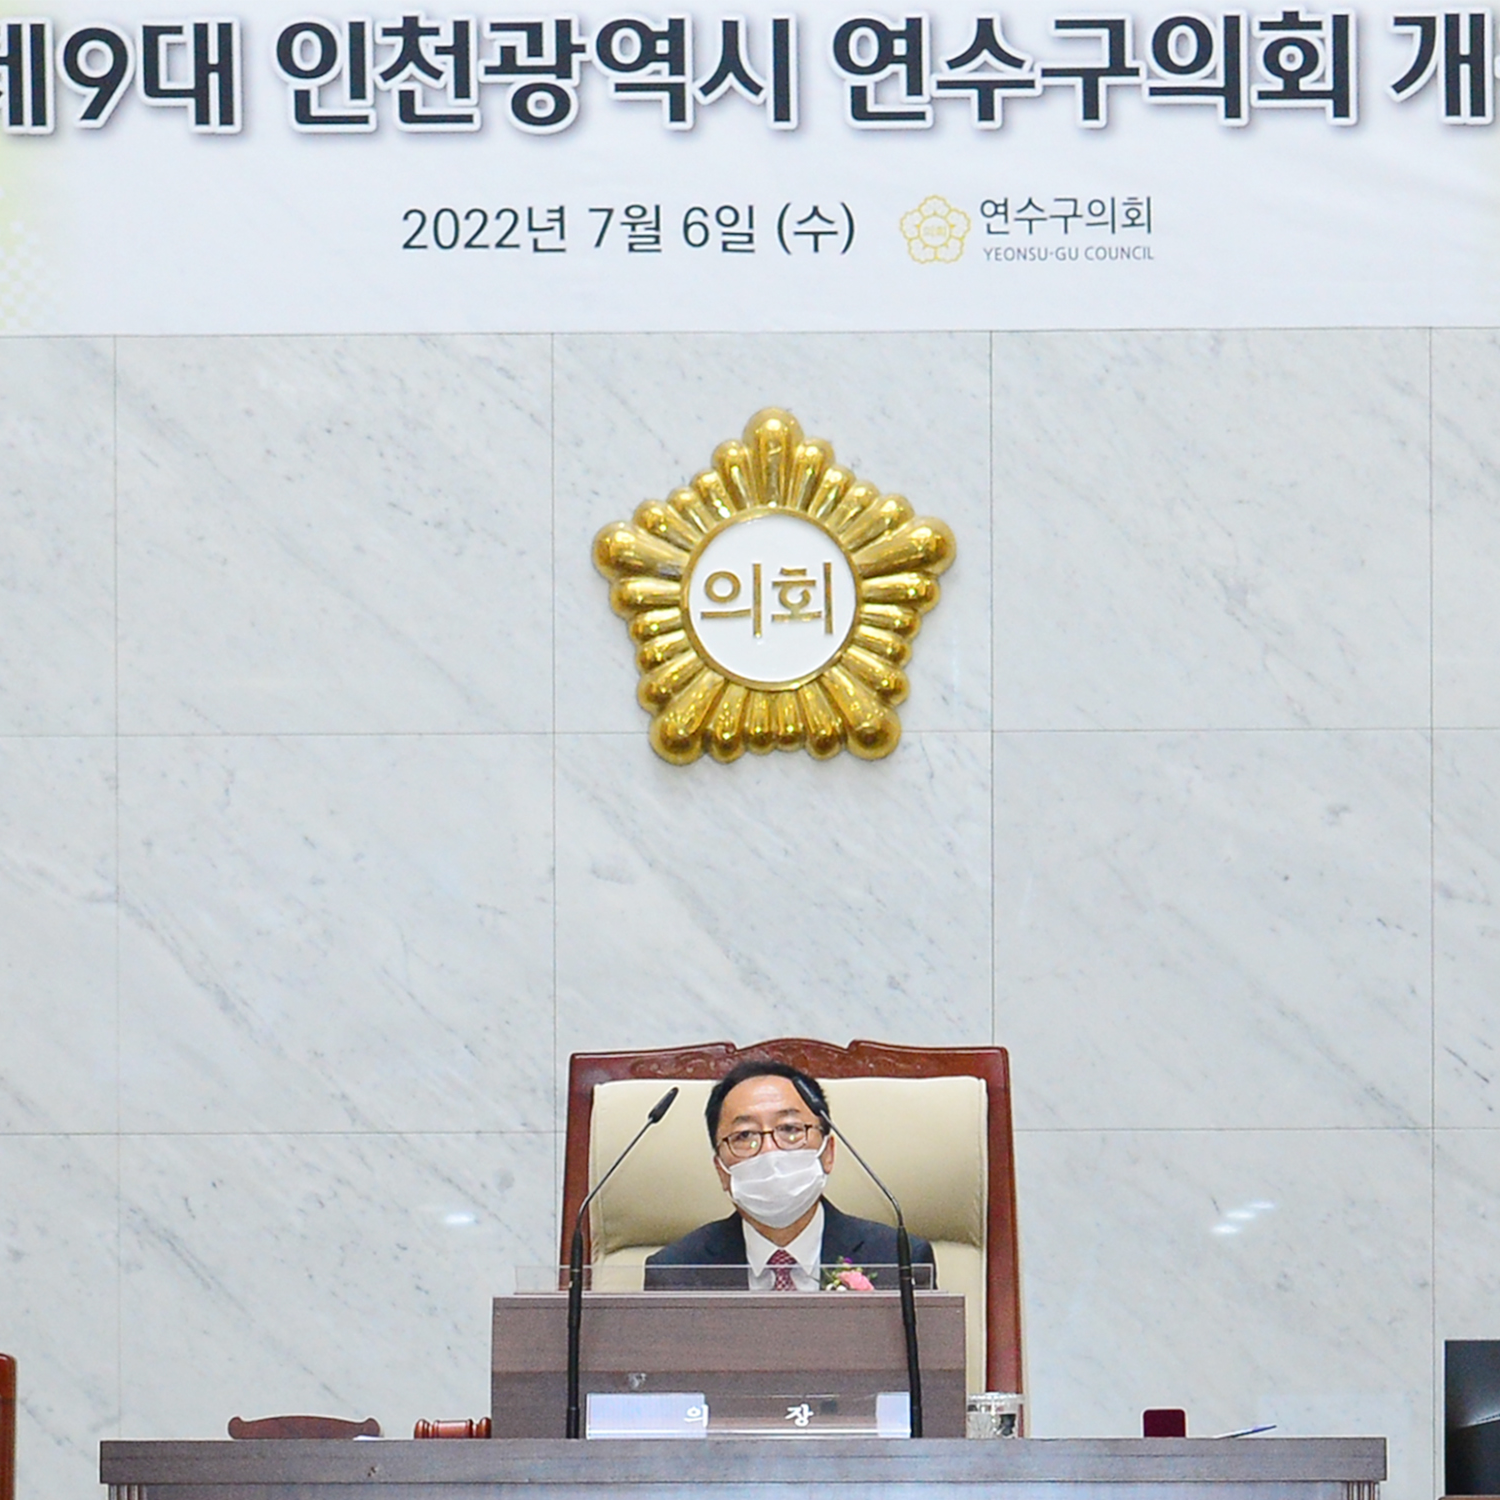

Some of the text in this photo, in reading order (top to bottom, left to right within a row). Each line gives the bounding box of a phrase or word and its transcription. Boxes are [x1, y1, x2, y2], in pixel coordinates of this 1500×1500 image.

[275, 15, 792, 127] 인천광역시
[832, 9, 1351, 122] 연수구의회
[402, 201, 856, 255] 2022년 7월 6일 (수)
[979, 196, 1153, 235] 연수구의회
[983, 244, 1155, 262] YEONSU-GU COUNCIL
[700, 561, 834, 638] 의회
